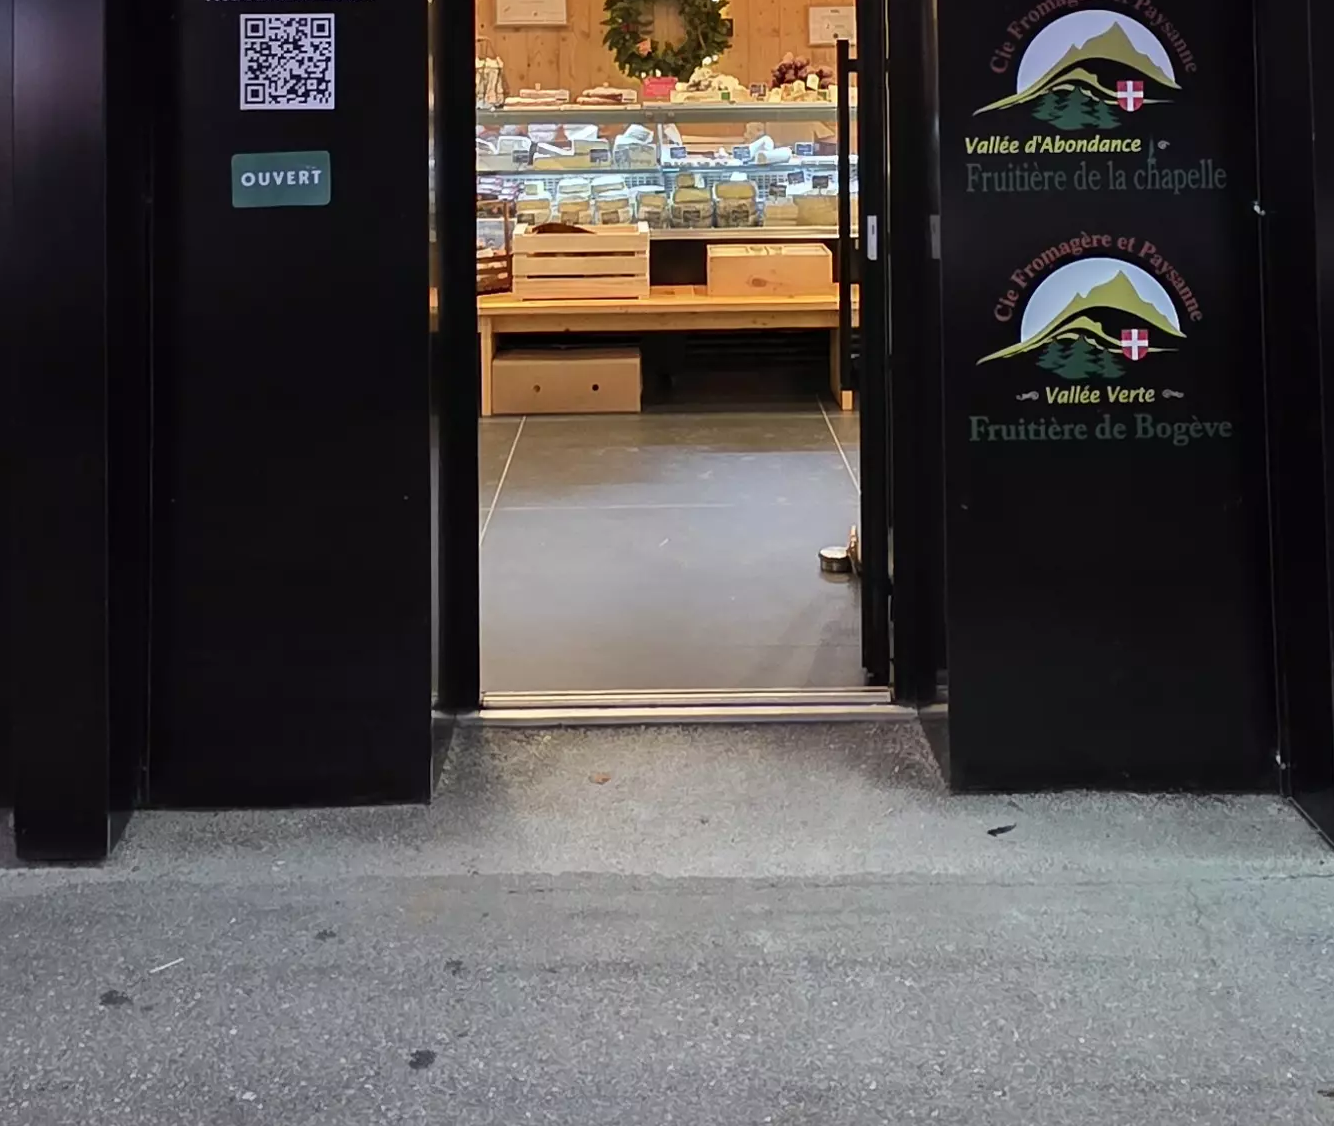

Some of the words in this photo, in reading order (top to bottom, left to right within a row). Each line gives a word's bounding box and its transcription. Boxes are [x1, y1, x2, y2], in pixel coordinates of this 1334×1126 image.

[990, 41, 1015, 74] Cie
[965, 136, 1019, 155] Vallée
[1024, 135, 1142, 154] d'Abondance
[241, 170, 322, 187] OUVERT
[966, 162, 1067, 193] Fruitière
[1074, 161, 1102, 191] de
[1108, 160, 1128, 190] la
[1133, 157, 1227, 195] chapelle
[993, 289, 1020, 323] Cie
[1011, 231, 1113, 289] Fromagère
[1117, 235, 1136, 253] et
[1138, 241, 1204, 323] Paysanne
[1045, 385, 1101, 404] Vallée
[1106, 386, 1156, 404] Verte
[968, 415, 1089, 442] Fruitière
[1095, 414, 1127, 439] de
[1134, 412, 1233, 447] Bogève
